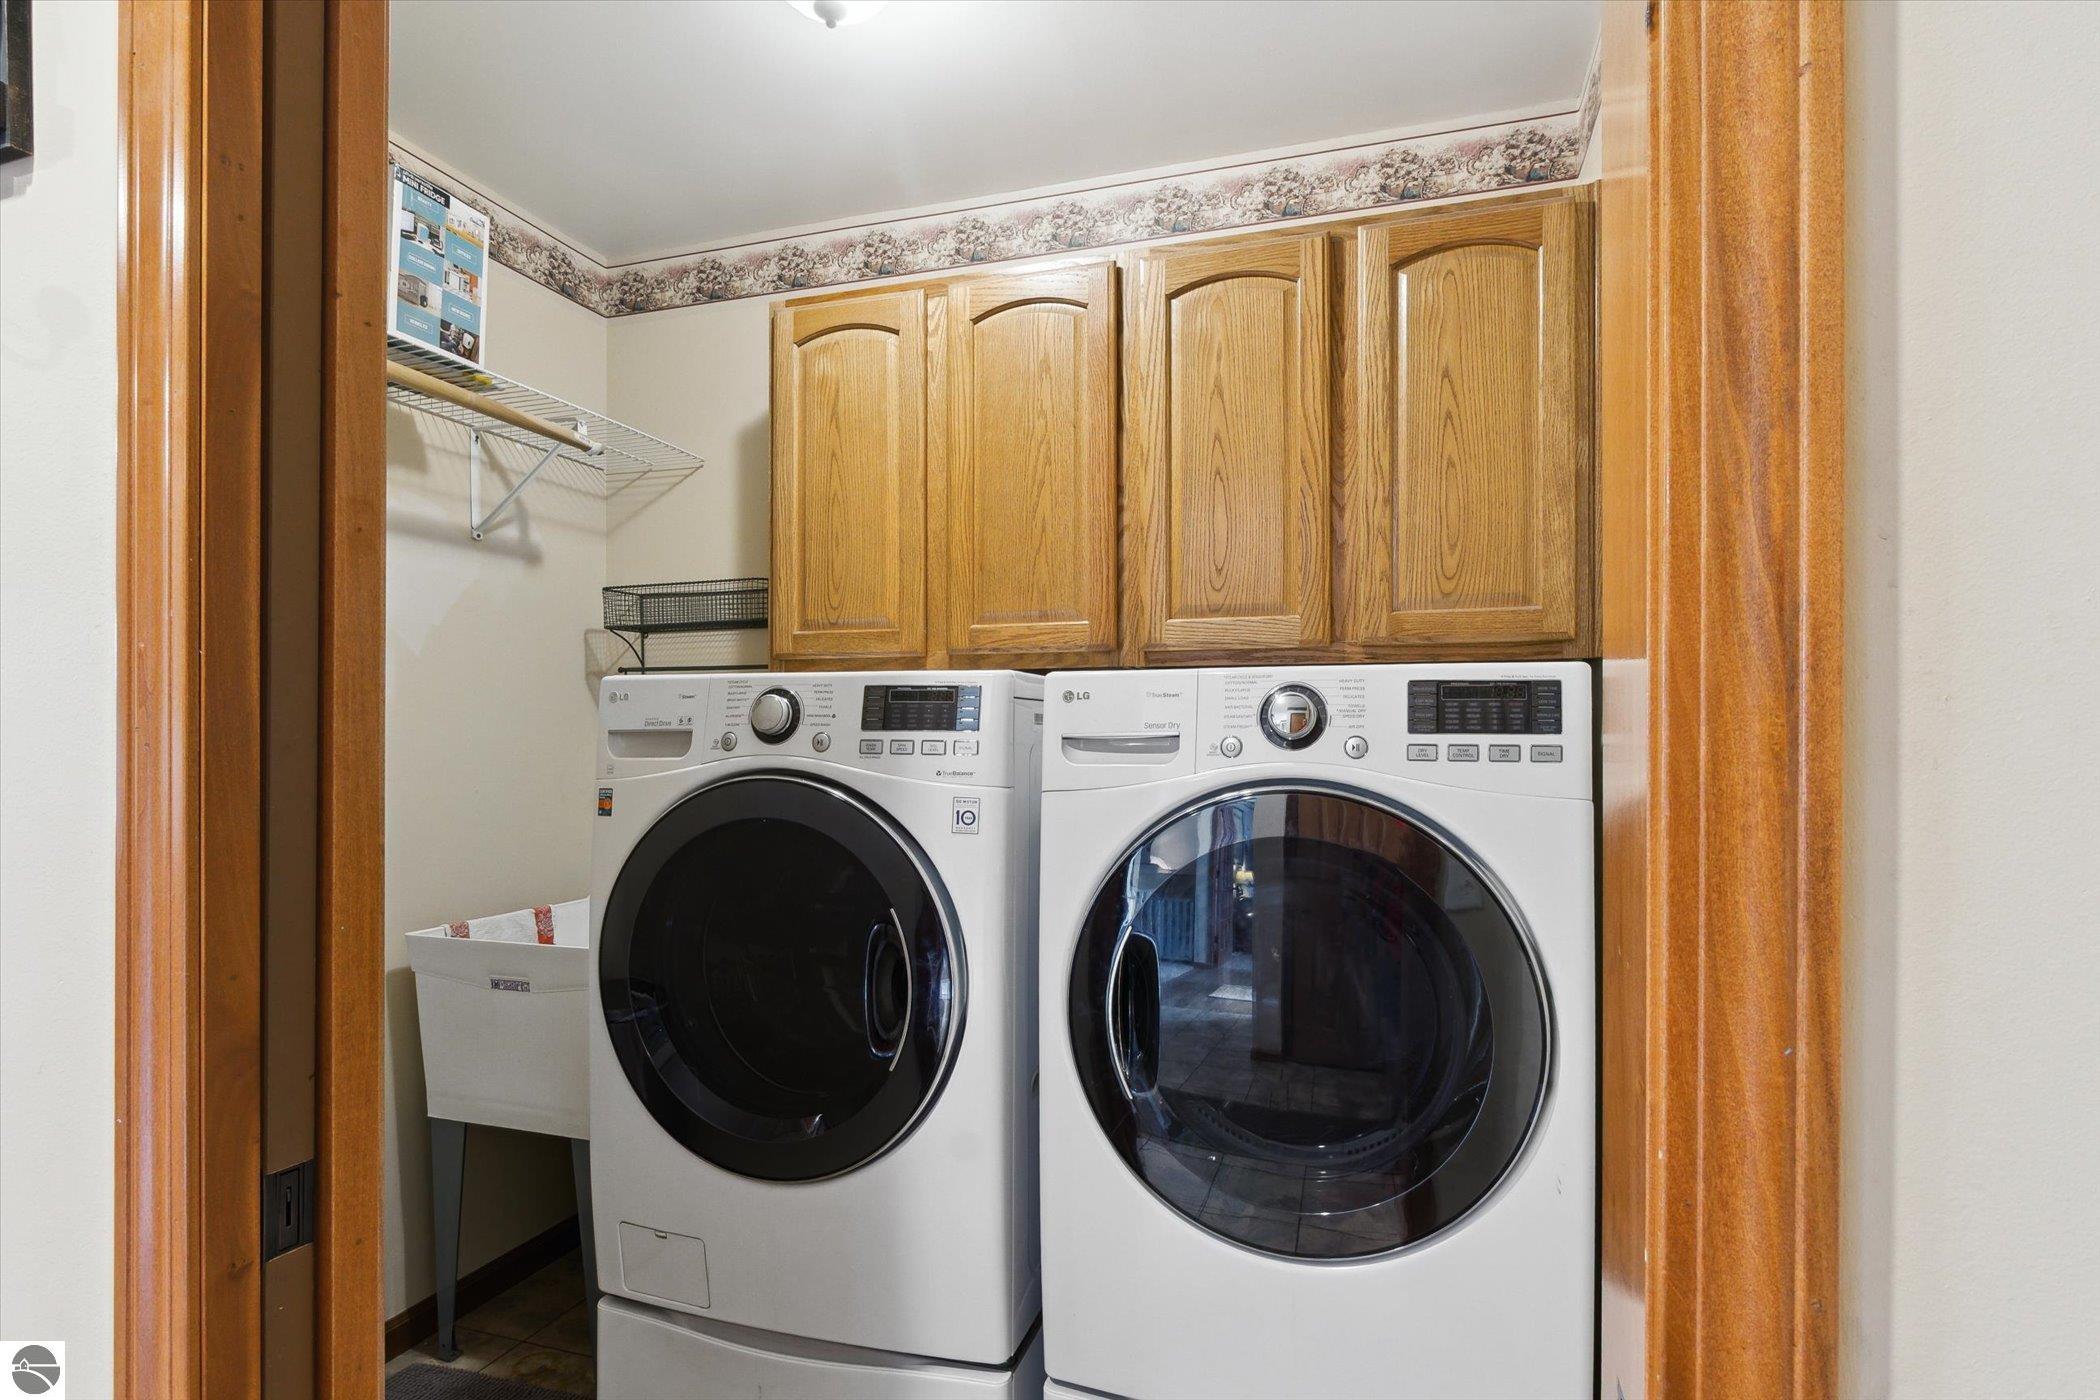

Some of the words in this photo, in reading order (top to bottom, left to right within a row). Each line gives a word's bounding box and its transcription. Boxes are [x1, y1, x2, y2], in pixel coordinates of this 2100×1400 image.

[402, 174, 419, 190] MINI
[420, 185, 446, 205] FRIDGE
[1077, 691, 1090, 700] LG
[1168, 721, 1181, 730] Dry
[955, 809, 976, 826] 10
